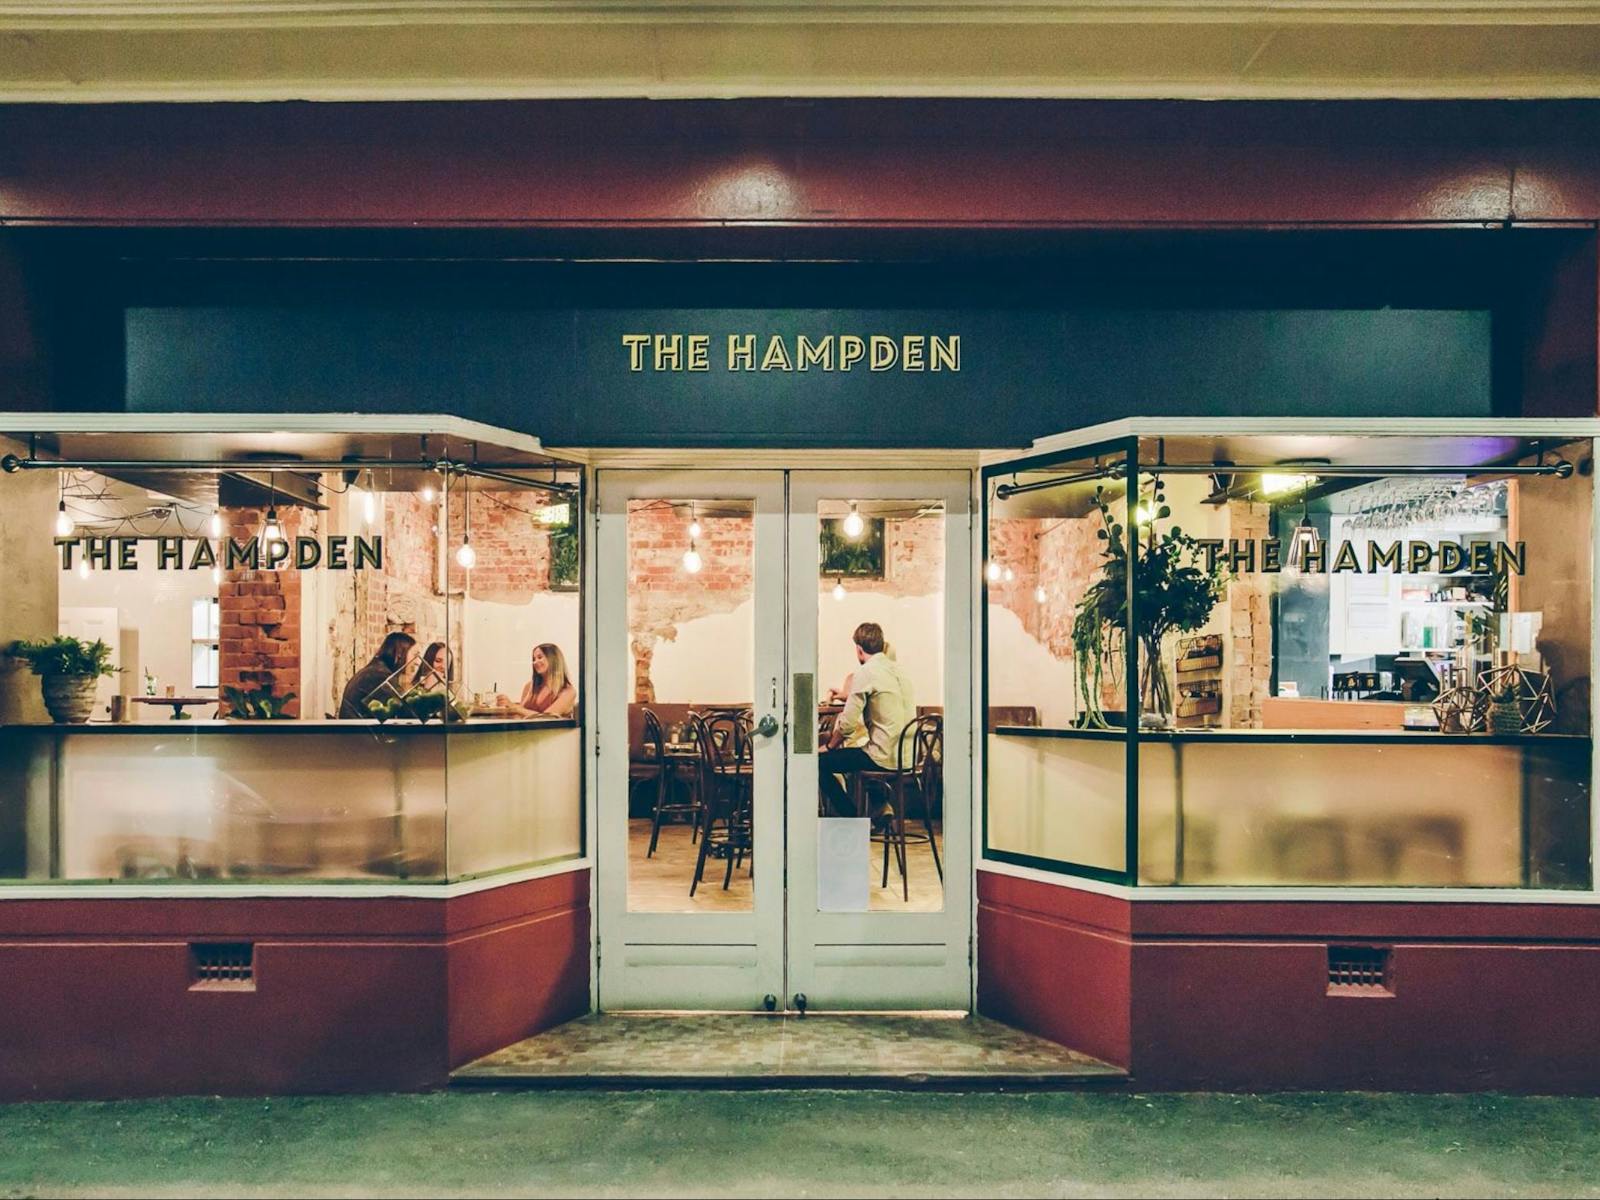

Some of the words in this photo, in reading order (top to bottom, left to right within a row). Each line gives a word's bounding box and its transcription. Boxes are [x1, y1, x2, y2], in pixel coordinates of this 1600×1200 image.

[622, 334, 710, 372] THE
[727, 334, 962, 372] HAMPDEN
[54, 536, 138, 571] THE
[157, 535, 383, 571] HAMPDEN
[1199, 538, 1282, 574] THE
[1299, 540, 1527, 576] HAMPDEN
